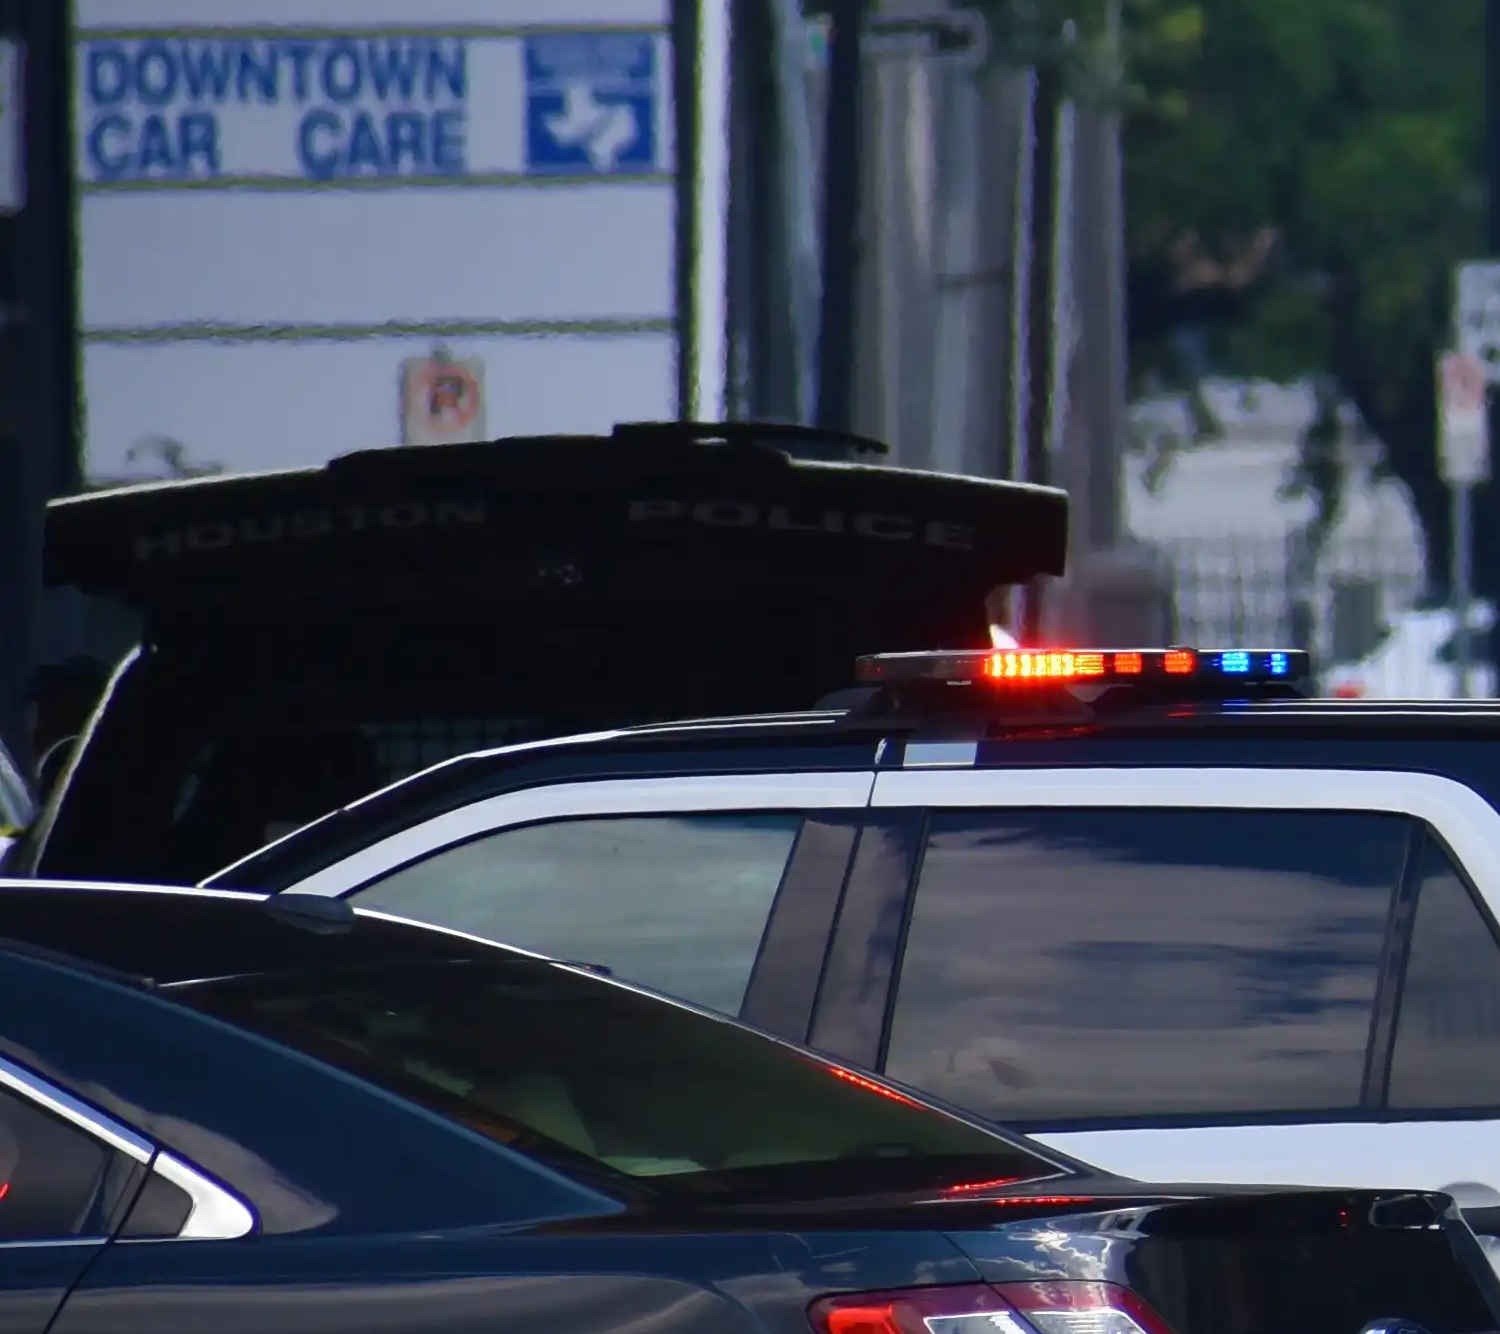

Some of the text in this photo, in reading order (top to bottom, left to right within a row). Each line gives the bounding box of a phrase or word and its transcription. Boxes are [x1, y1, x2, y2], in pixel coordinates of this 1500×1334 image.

[89, 39, 465, 104] DOWNTOWN
[89, 110, 465, 170] CAR CARE
[135, 497, 977, 562] HOUSTON POLICE
